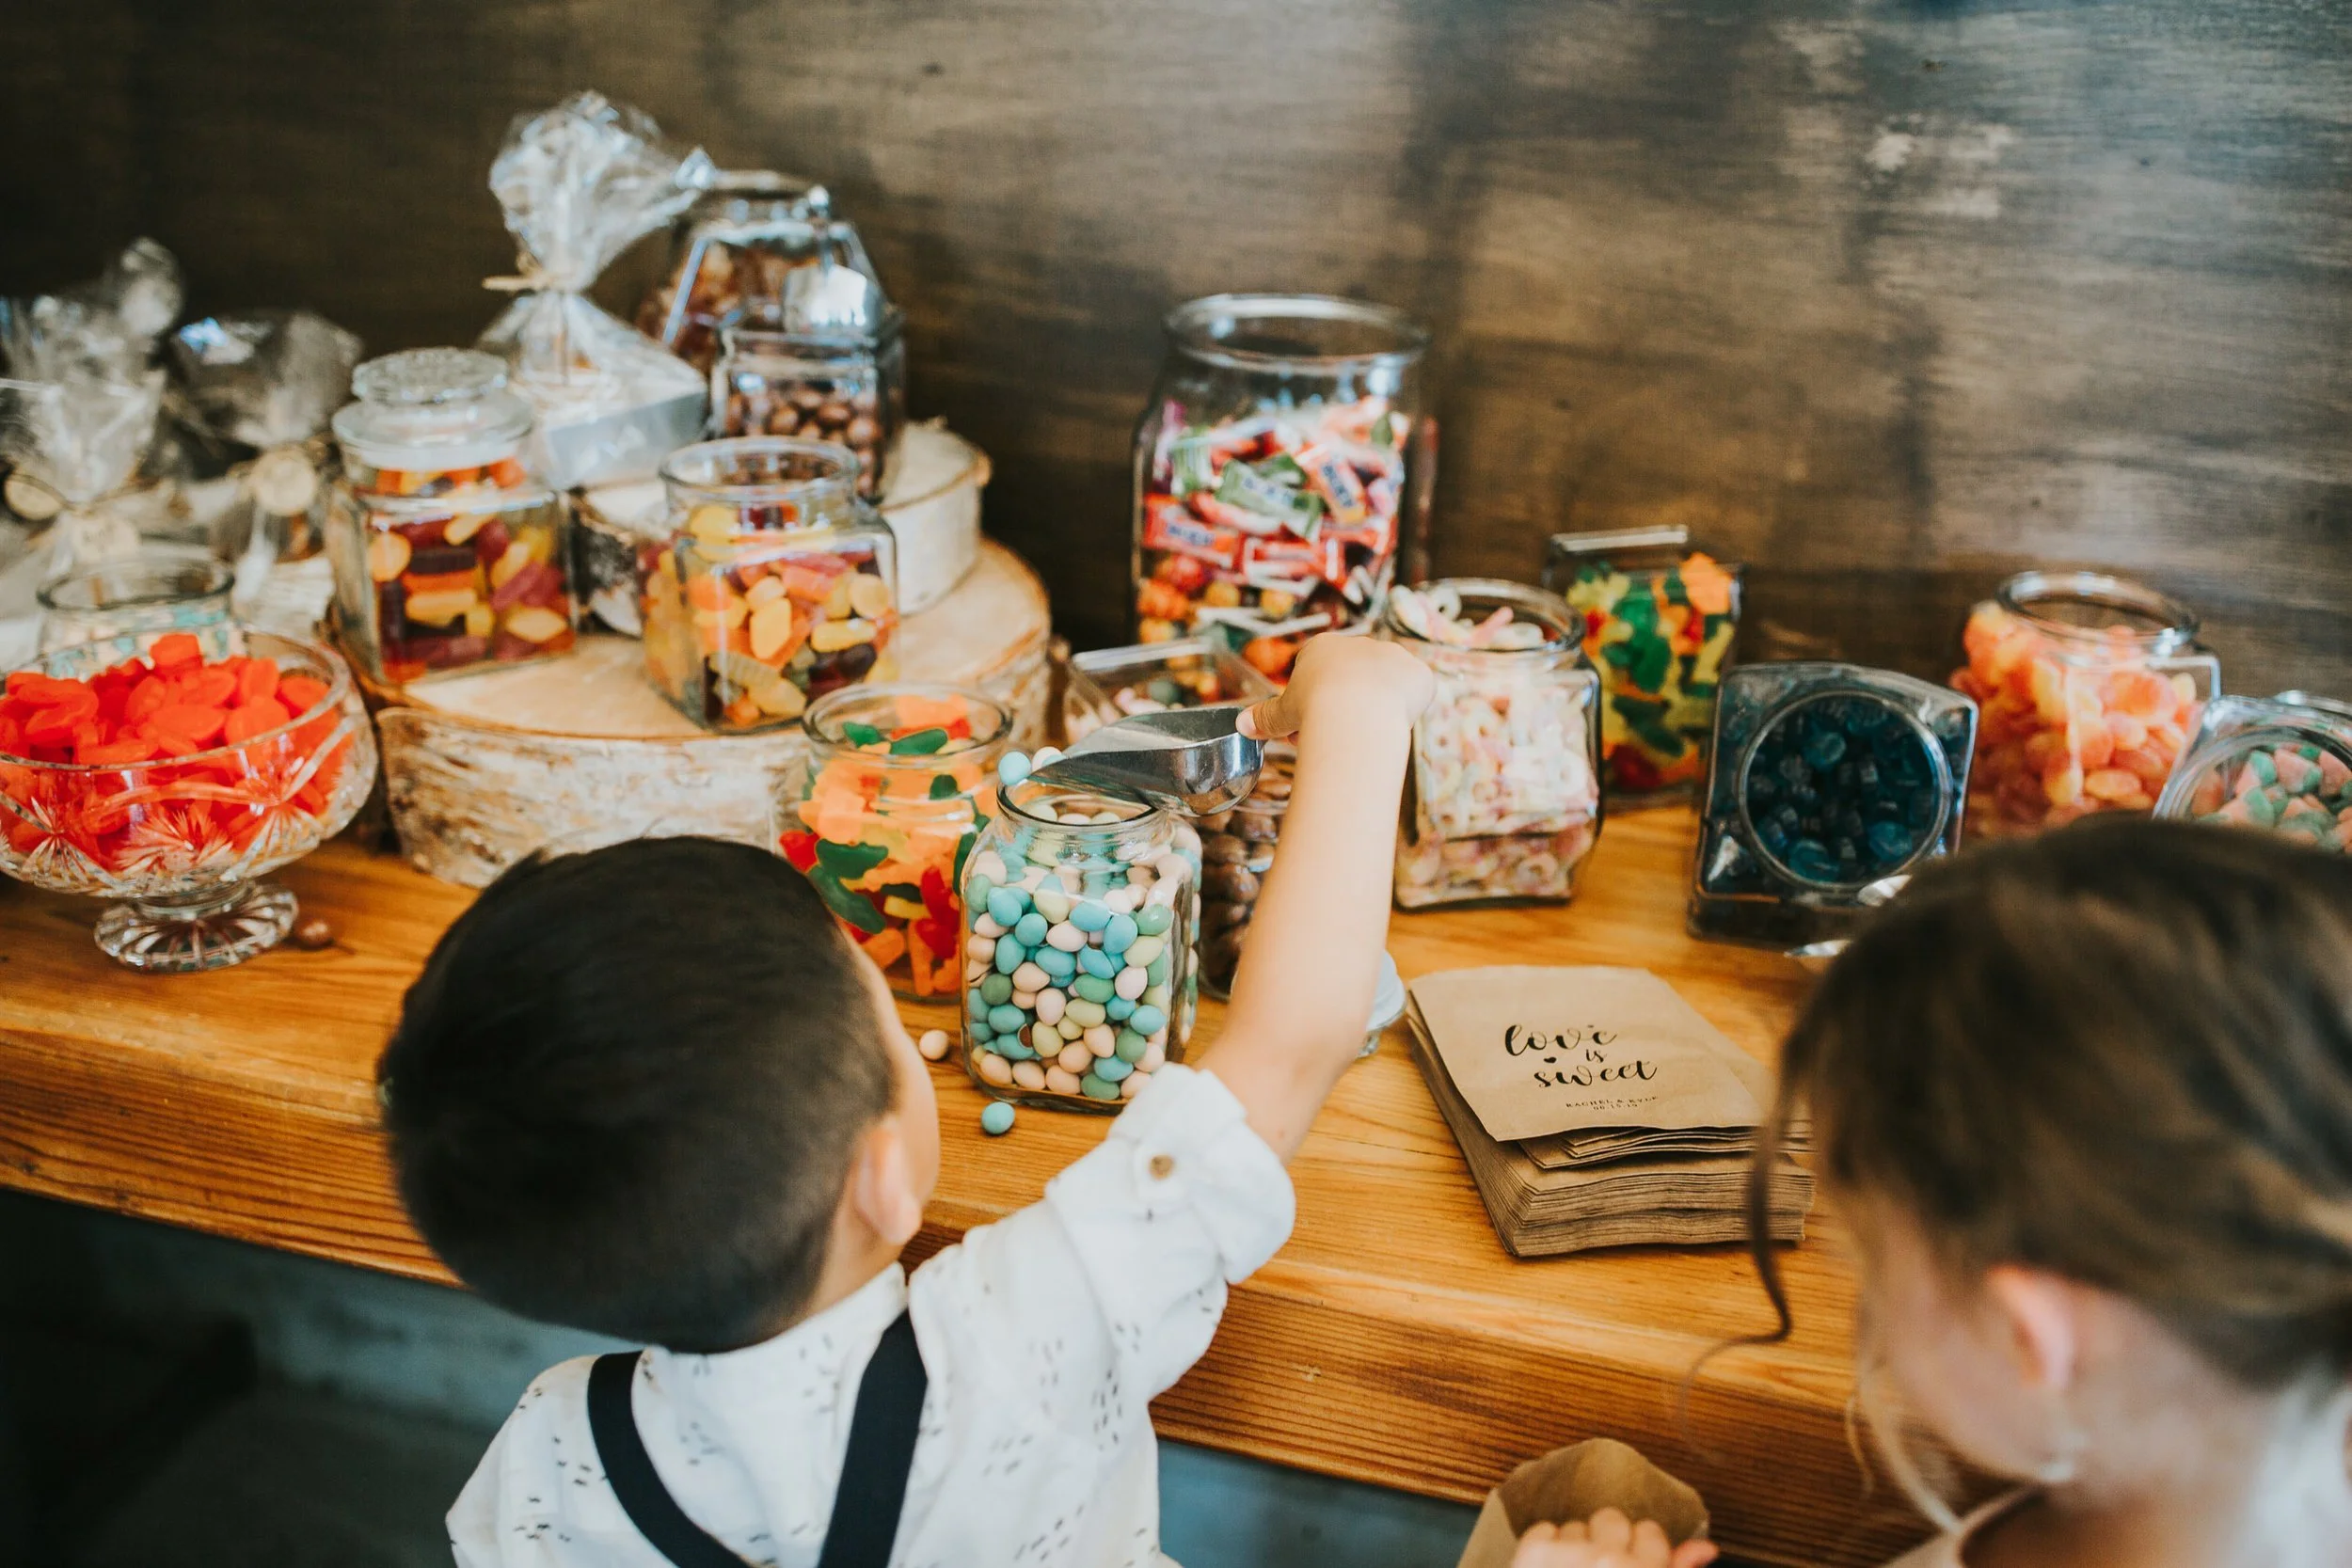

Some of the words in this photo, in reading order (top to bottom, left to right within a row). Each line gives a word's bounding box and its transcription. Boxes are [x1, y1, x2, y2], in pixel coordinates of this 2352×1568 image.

[1504, 1023, 1618, 1056] love
[1586, 1048, 1608, 1063] is
[1534, 1060, 1658, 1088] sweet
[1565, 1099, 1613, 1108] RACHEL
